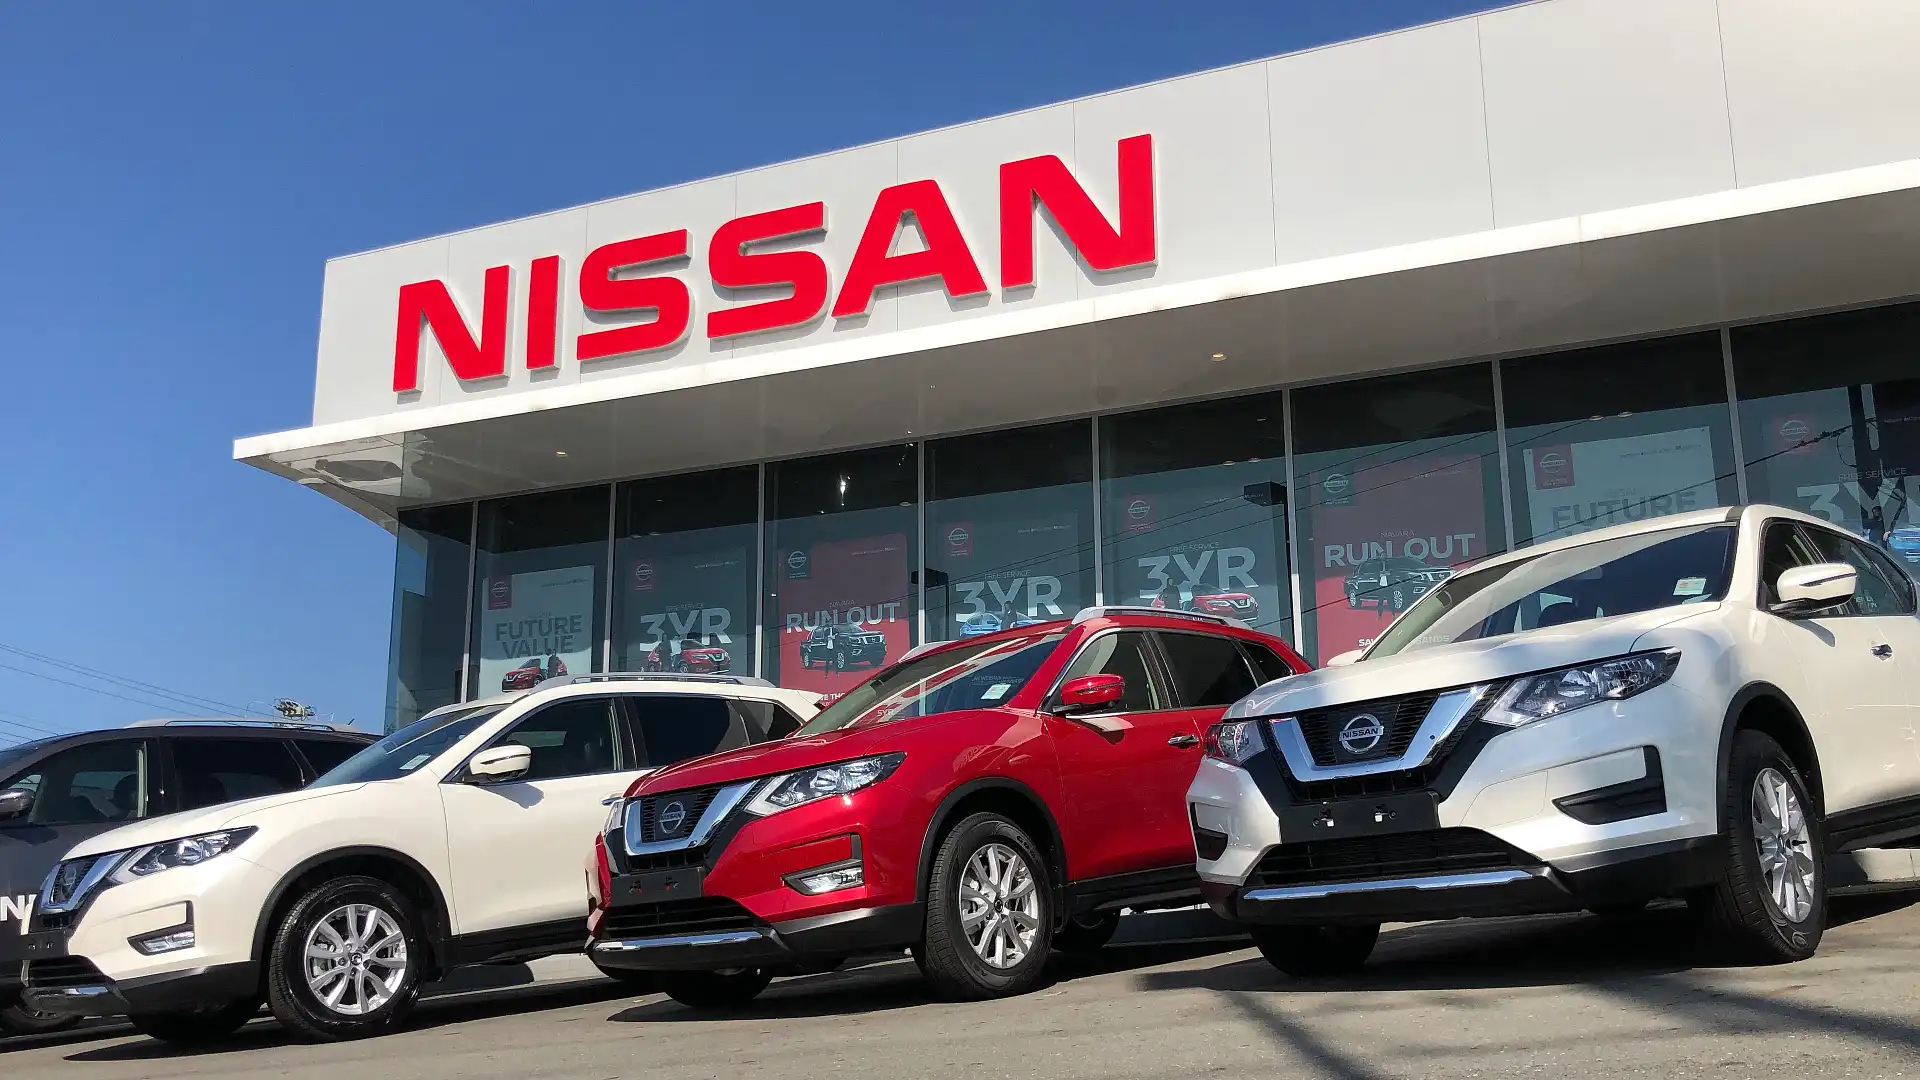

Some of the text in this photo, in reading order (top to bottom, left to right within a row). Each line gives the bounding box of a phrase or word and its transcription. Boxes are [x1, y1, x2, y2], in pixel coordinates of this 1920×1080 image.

[393, 133, 1157, 395] NISSAN
[1866, 467, 1907, 479] SERVICE
[1551, 490, 1696, 531] FUTURE
[1189, 542, 1220, 551] SERVICE
[1324, 533, 1475, 568] RUN OUT
[984, 570, 1031, 580] FREE SERVICE
[1138, 546, 1259, 599] 3YR
[955, 575, 1064, 623] 3YR
[496, 614, 583, 641] FUTURE
[639, 607, 733, 651] 3YR
[786, 602, 901, 634] RUN OUT
[502, 635, 574, 658] VALUE
[1342, 728, 1379, 739] NISSAN
